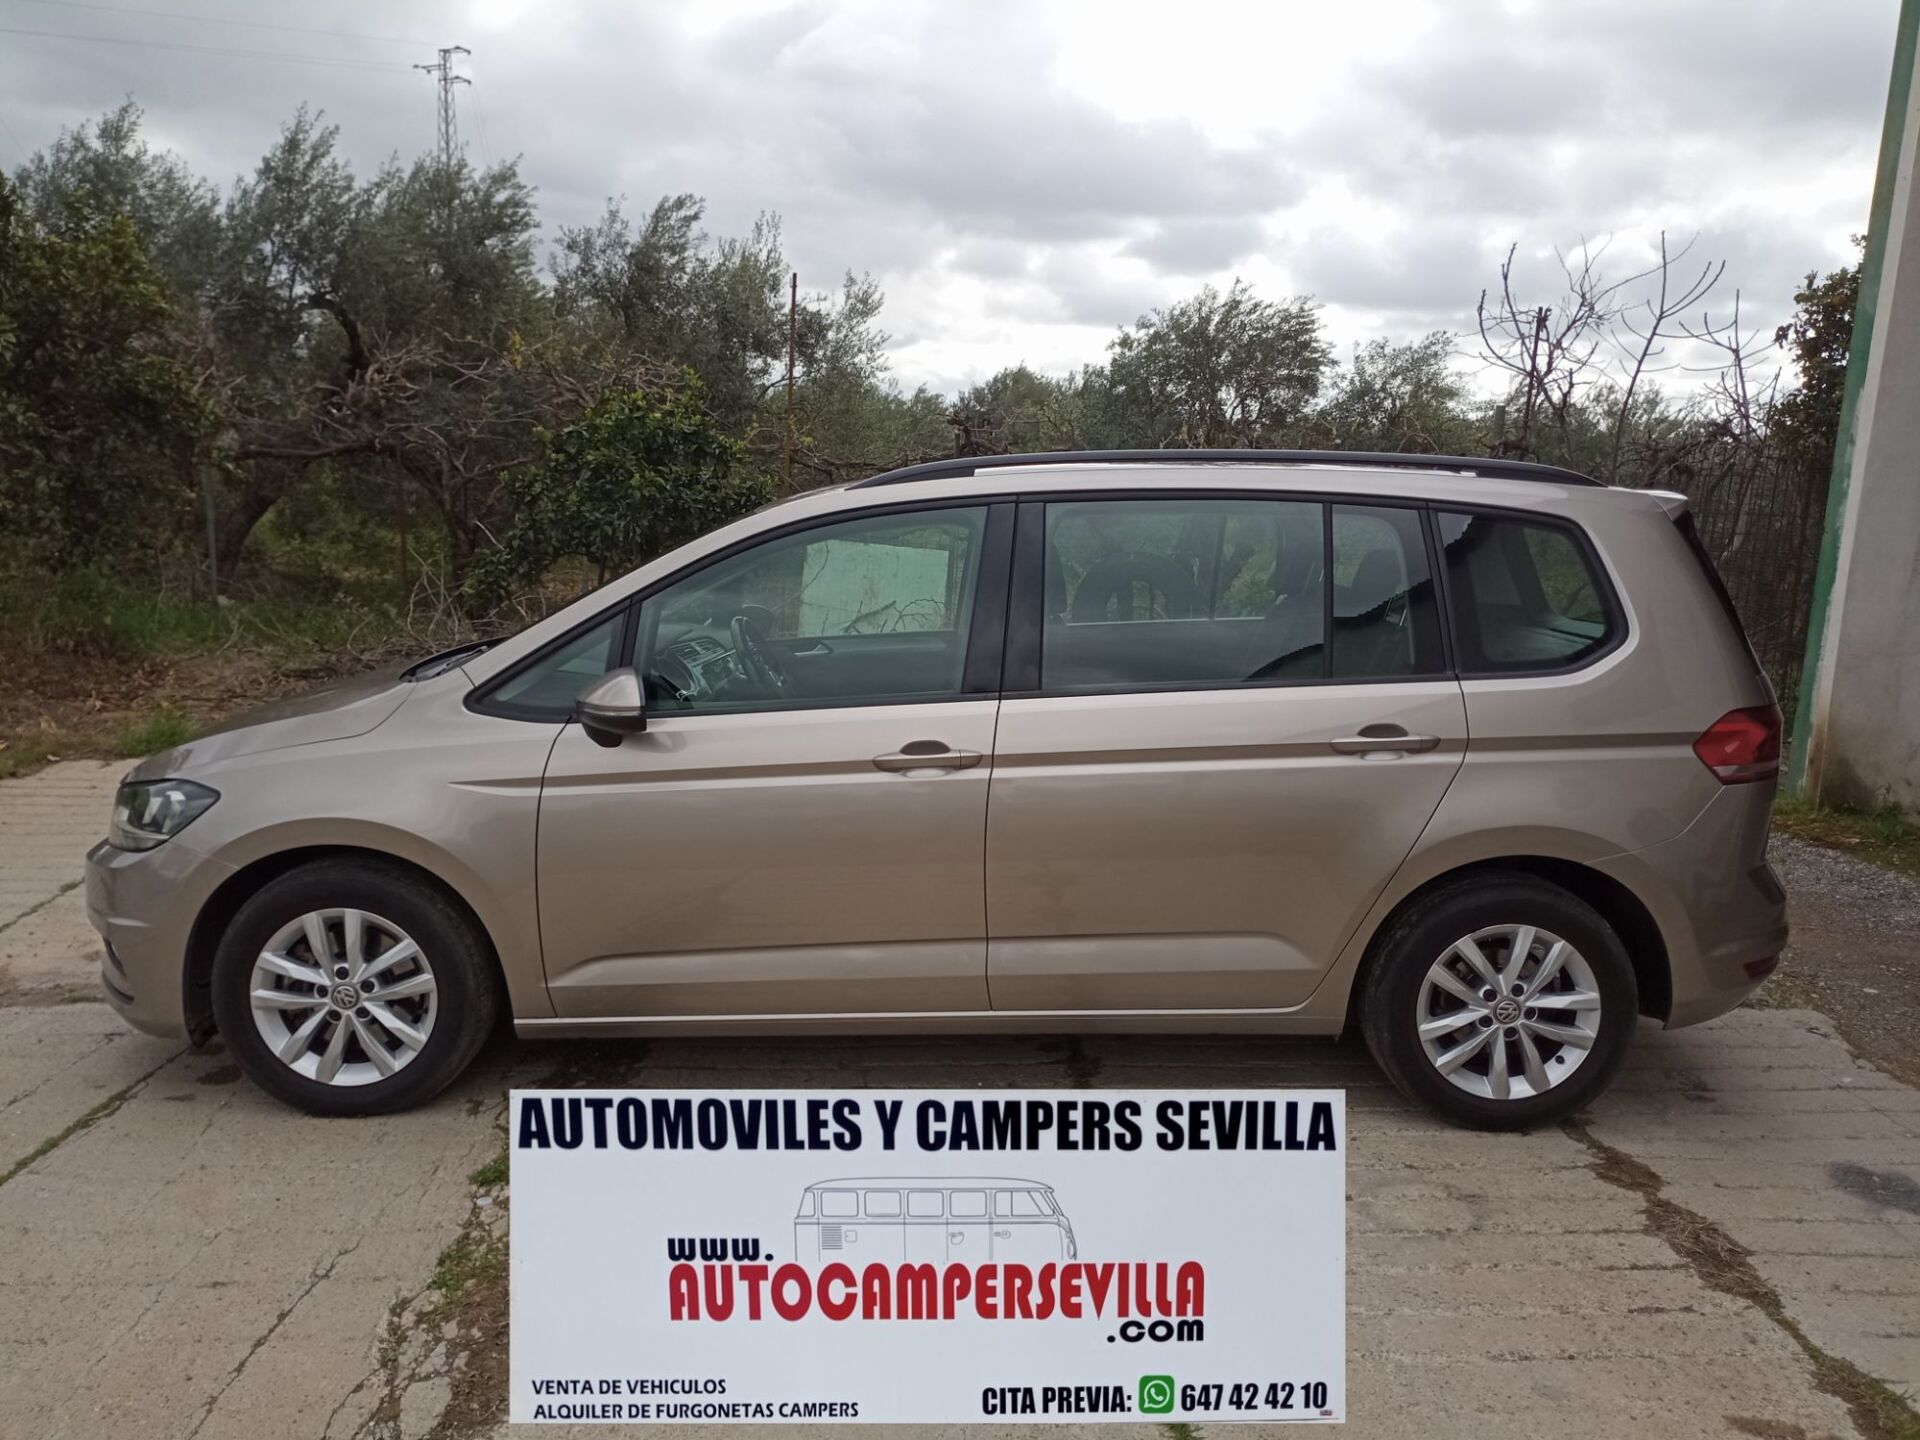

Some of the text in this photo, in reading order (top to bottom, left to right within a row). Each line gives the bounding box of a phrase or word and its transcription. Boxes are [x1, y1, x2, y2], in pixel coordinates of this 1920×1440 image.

[518, 1097, 1337, 1151] AUTOMOVILES Y CAMPERS SEVILLA
[668, 1238, 774, 1262] www.
[668, 1262, 1205, 1321] AUTOCAMPERSEVILLA
[1106, 1319, 1204, 1343] .com
[532, 1379, 727, 1396] VENTA DE VEHICULOS
[982, 1381, 1328, 1416] CITA PREVIA: 647 42 42 10
[533, 1402, 859, 1420] ALQUILER DE FURGONETAS CAMPERS
